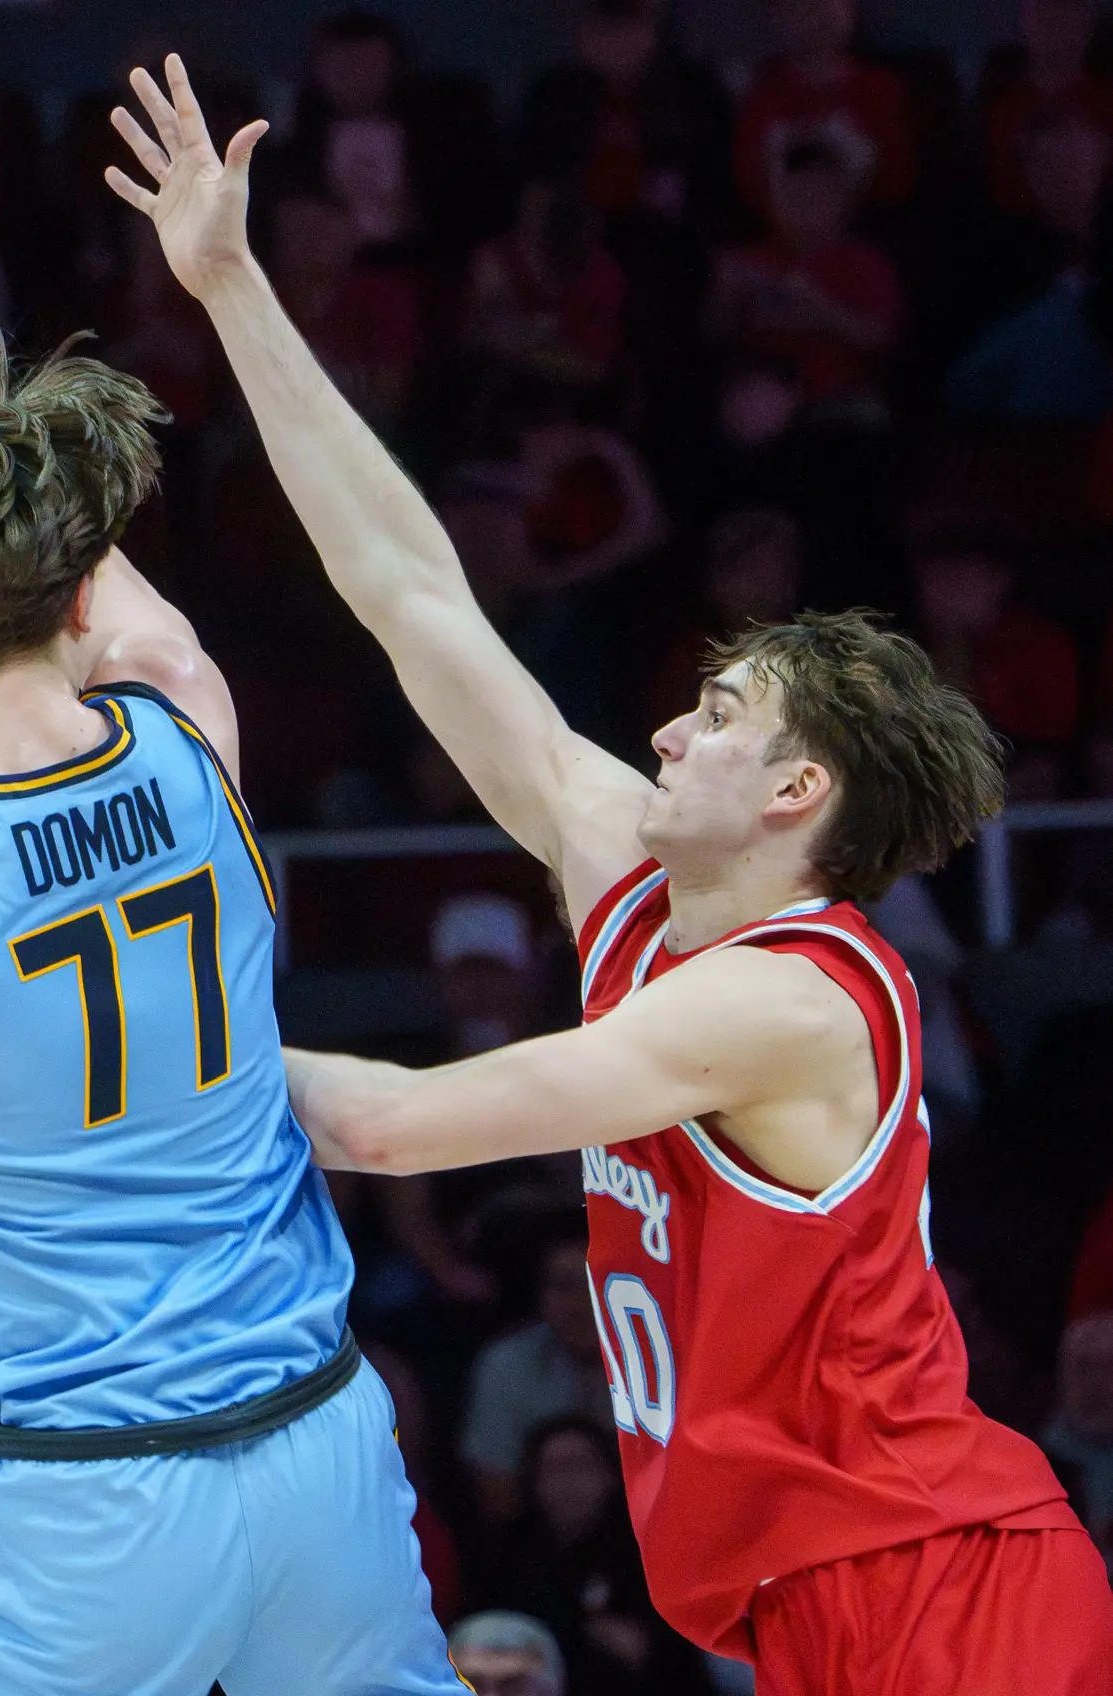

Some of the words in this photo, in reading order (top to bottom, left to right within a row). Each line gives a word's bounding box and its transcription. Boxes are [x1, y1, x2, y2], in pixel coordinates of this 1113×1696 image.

[11, 777, 176, 897] DOMON
[7, 862, 231, 1130] 77
[585, 1262, 676, 1448] 10
